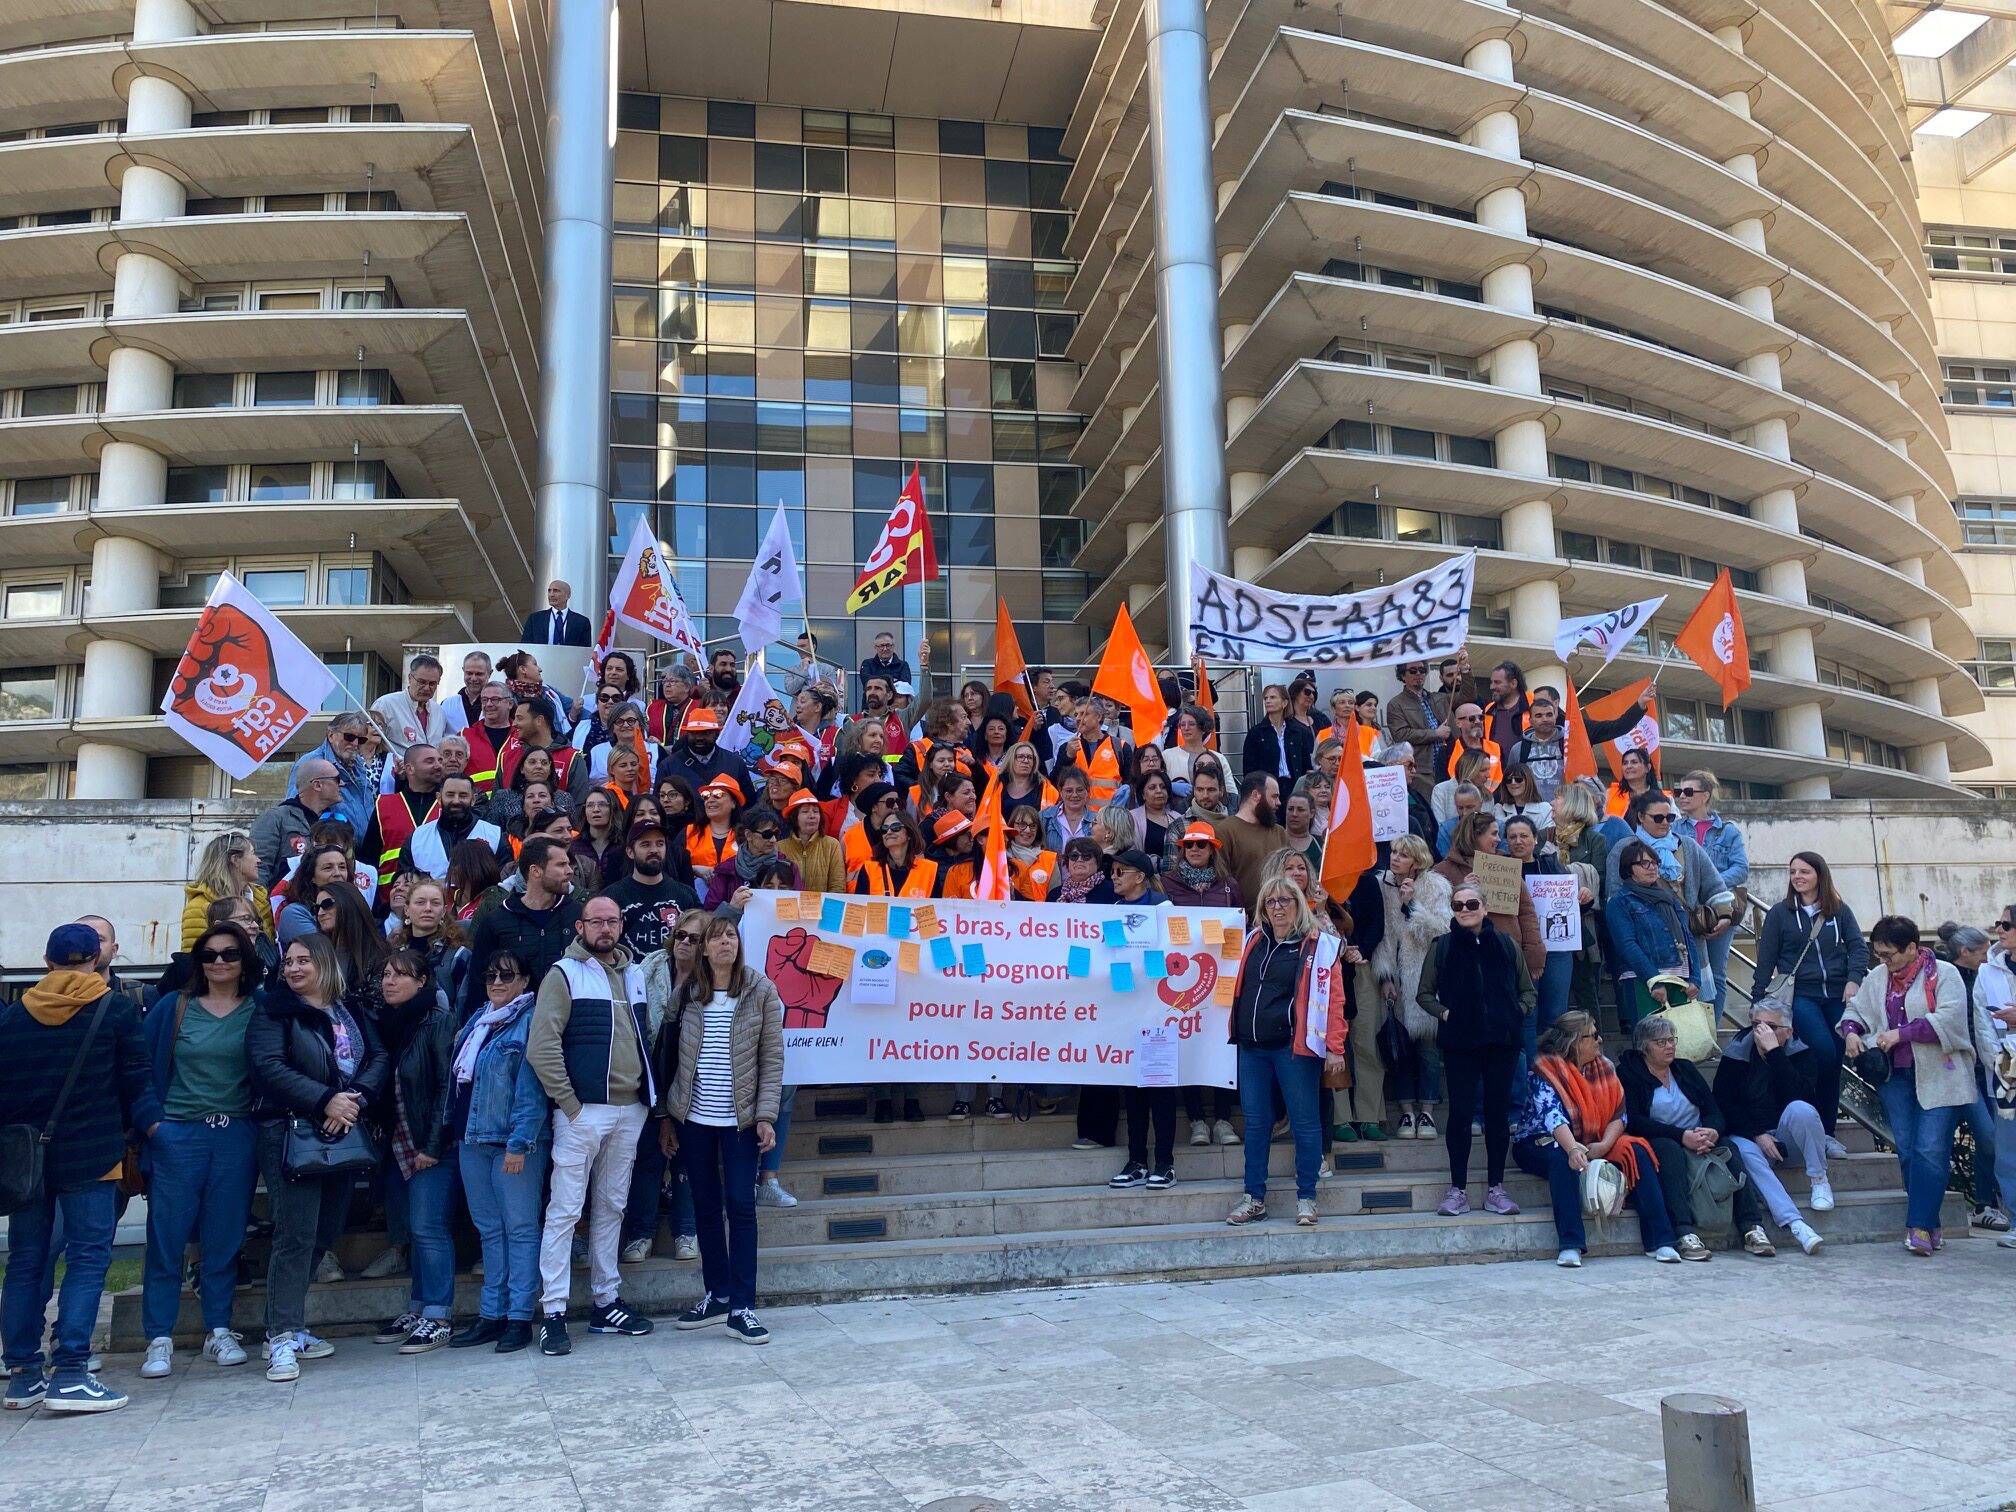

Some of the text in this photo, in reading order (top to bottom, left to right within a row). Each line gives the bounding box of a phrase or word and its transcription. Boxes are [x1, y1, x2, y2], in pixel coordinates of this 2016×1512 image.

[1195, 631, 1245, 661] EN
[956, 913, 1011, 941] bras,
[1019, 916, 1059, 938] des
[909, 999, 1098, 1021] pour la Santé et
[815, 1036, 839, 1047] RIEN
[869, 1038, 959, 1060] l'Action
[967, 1040, 1051, 1062] Sociale
[1058, 1042, 1087, 1062] du
[1095, 1044, 1134, 1064] Var
